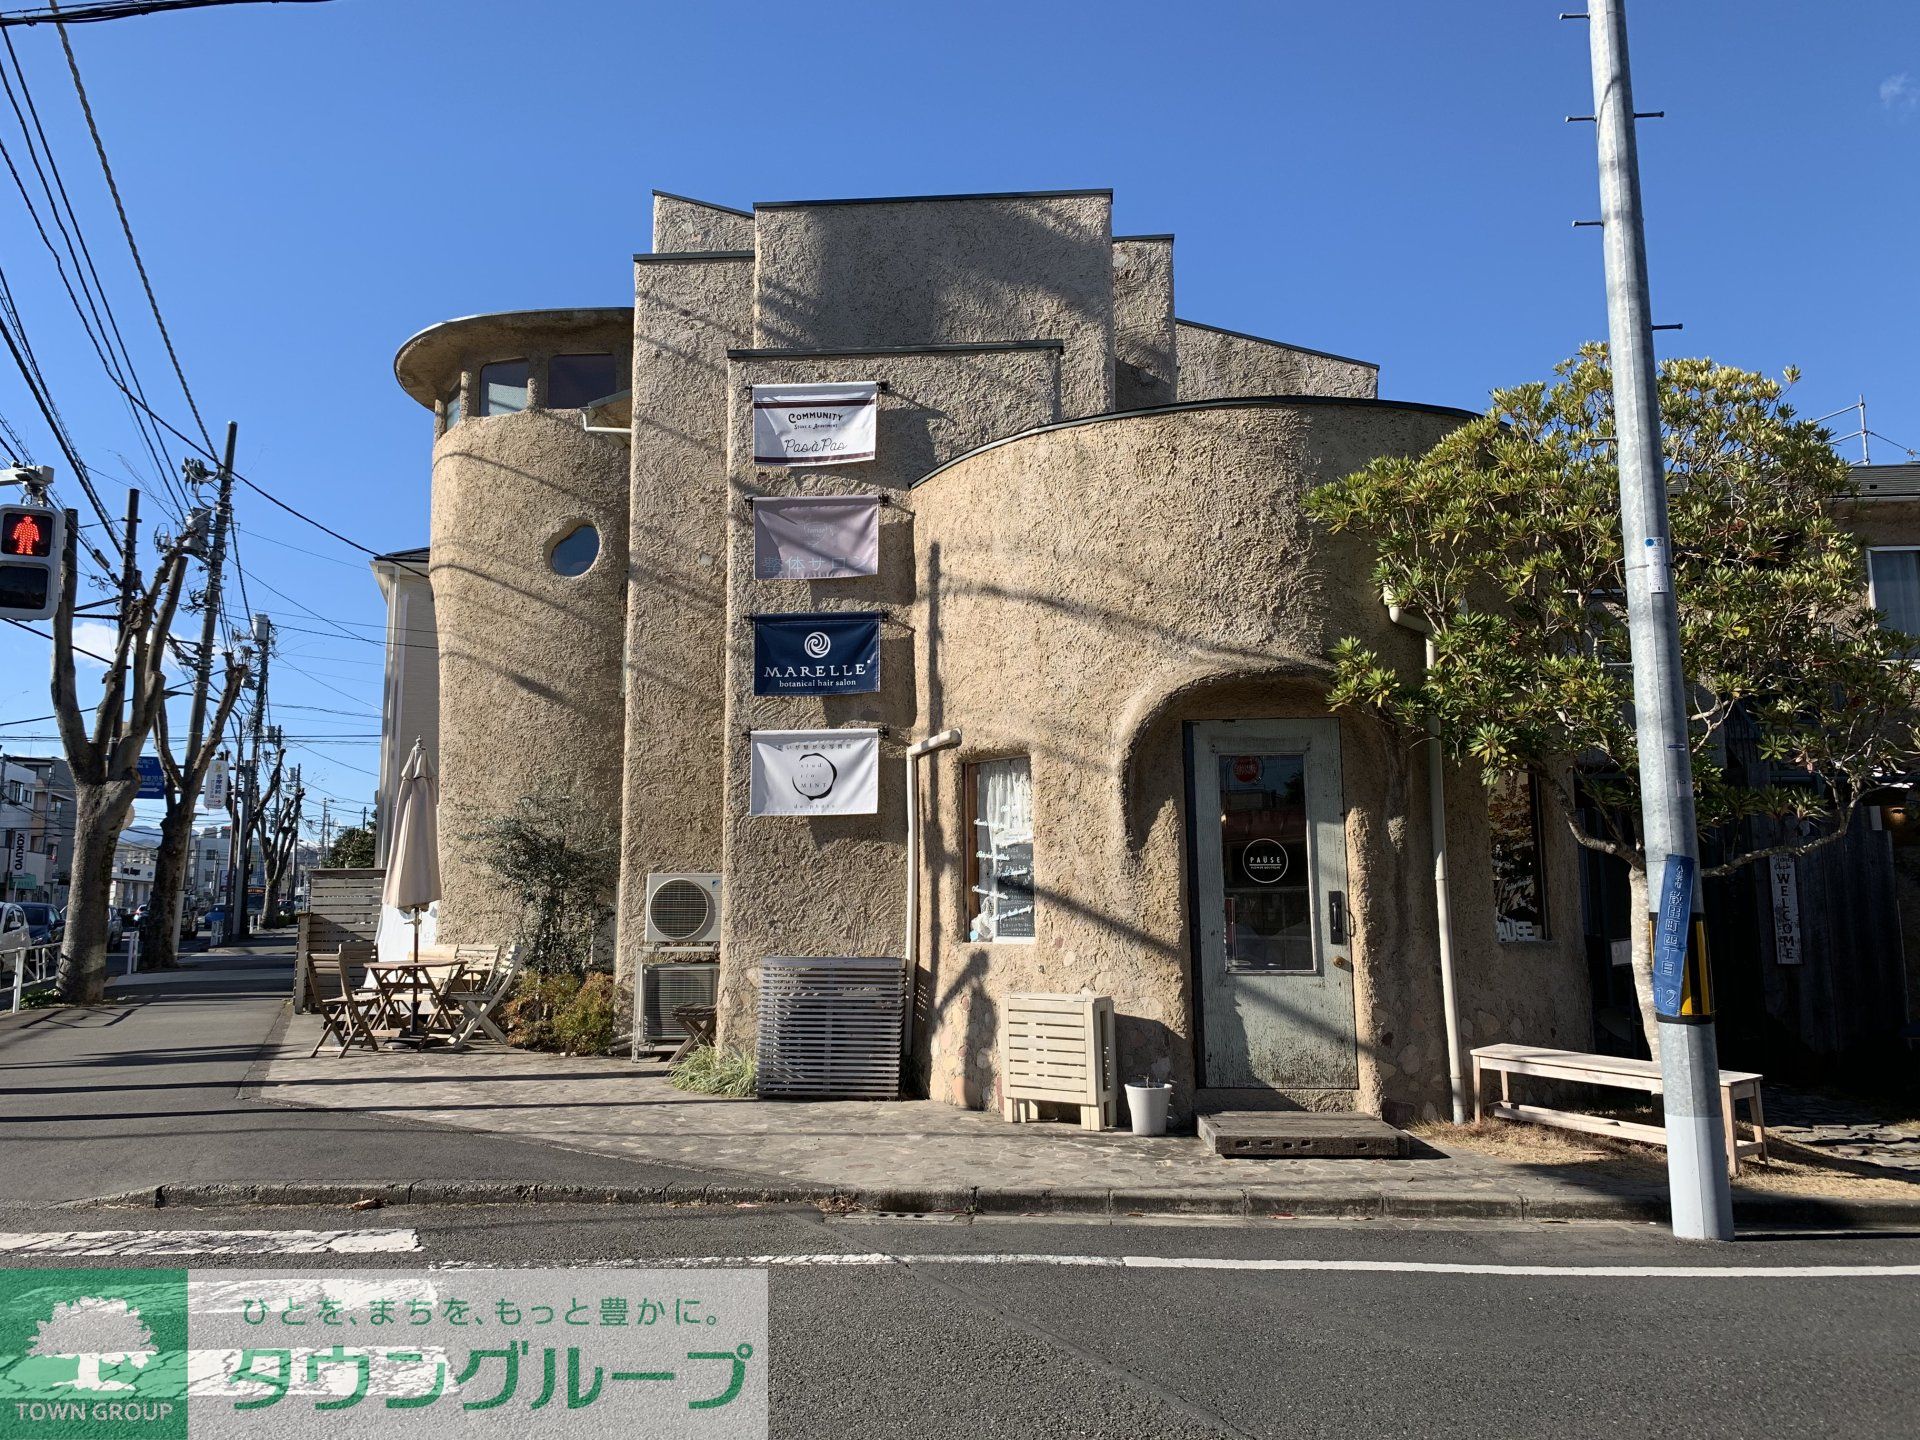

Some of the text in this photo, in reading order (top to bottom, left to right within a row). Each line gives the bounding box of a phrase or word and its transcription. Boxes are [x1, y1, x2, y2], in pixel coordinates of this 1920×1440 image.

[762, 555, 868, 573] 整体サロン
[763, 663, 866, 678] MARELLE
[779, 678, 857, 688] botanical hair salon
[14, 832, 25, 871] KOKUYO
[1250, 856, 1281, 864] PAUSE
[1776, 873, 1794, 959] WELCOME
[1656, 987, 1678, 1006] 12
